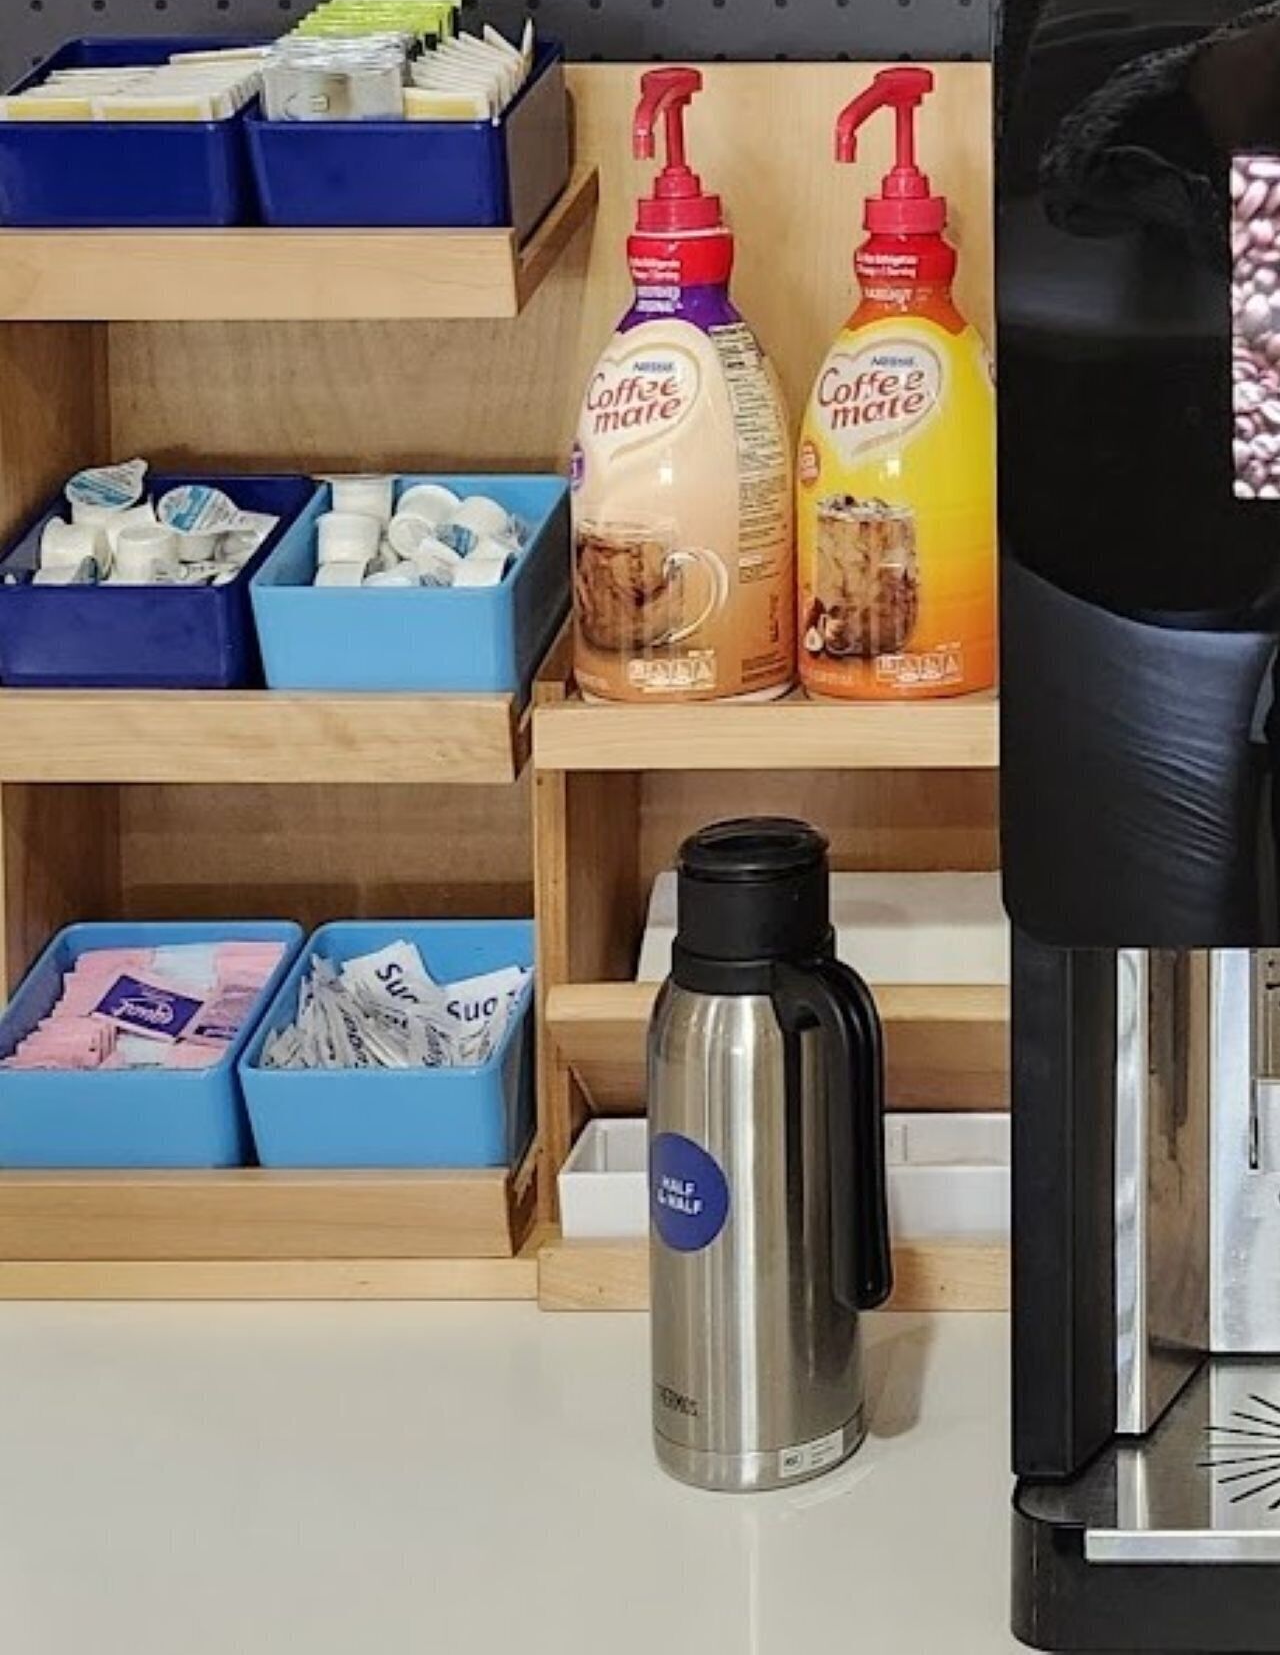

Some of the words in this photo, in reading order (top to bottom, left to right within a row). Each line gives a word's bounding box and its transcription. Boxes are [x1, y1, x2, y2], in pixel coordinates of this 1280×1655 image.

[587, 371, 679, 411] Coffee
[817, 367, 925, 407] Coffee
[593, 398, 682, 434] mate
[831, 393, 925, 431] mate
